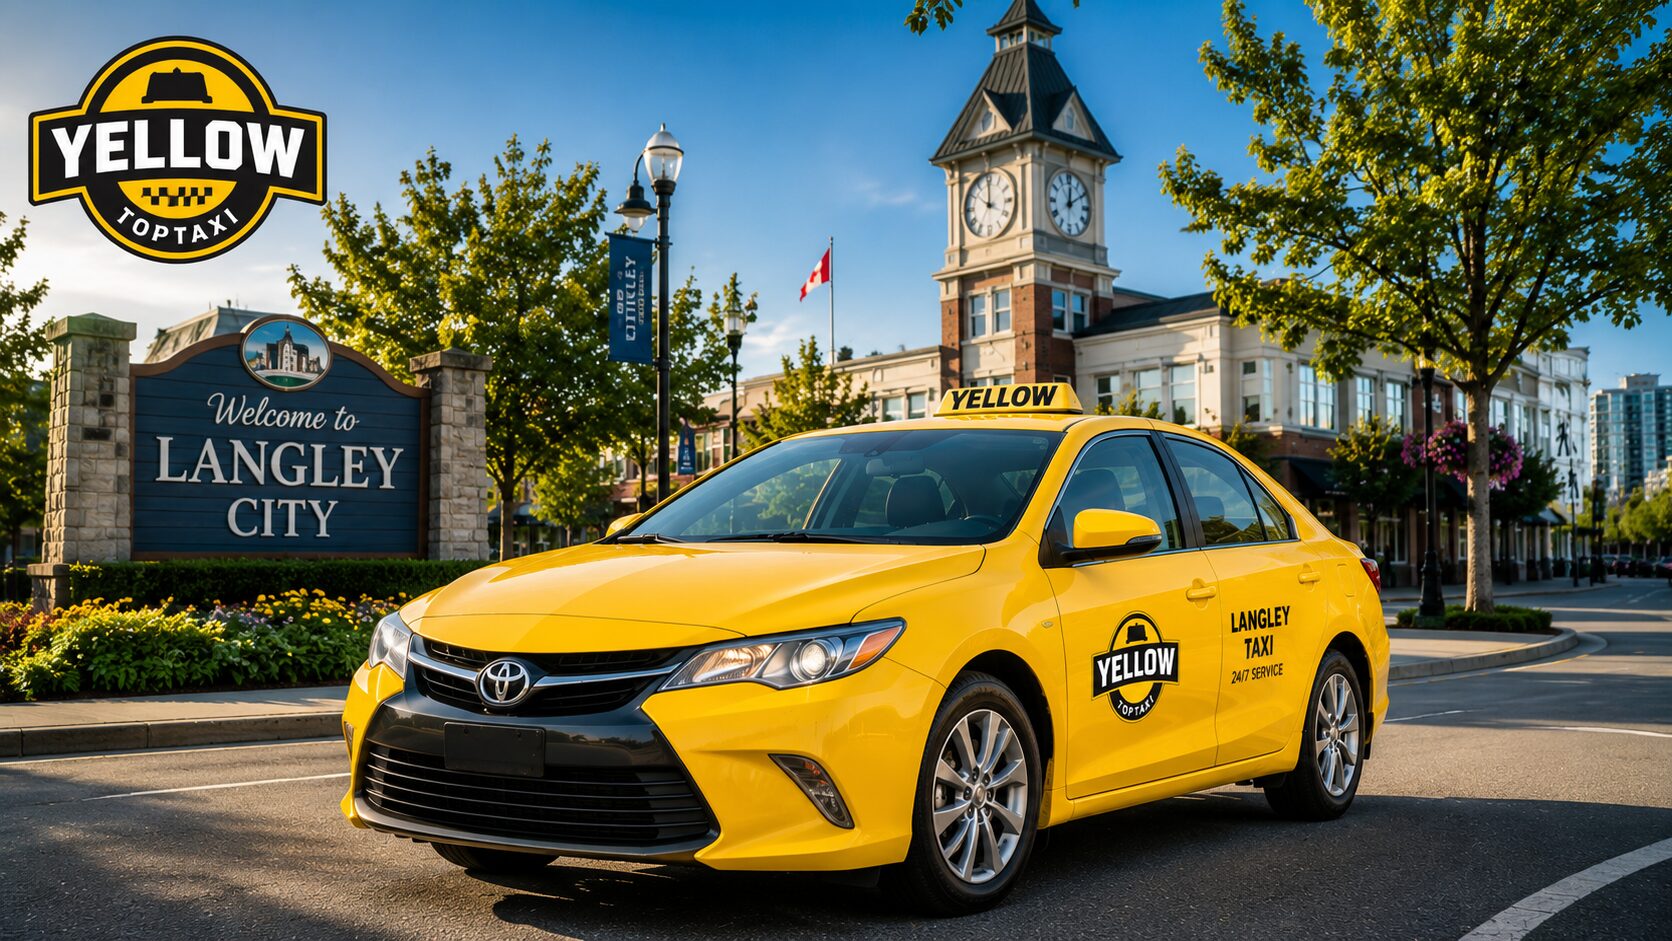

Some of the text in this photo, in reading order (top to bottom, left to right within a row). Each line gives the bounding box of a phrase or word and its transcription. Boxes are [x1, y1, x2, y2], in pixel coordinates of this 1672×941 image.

[207, 392, 360, 431] Welcome to
[951, 385, 1058, 411] YELLOW
[155, 436, 404, 489] LANGLEY
[227, 497, 338, 538] CITY
[1231, 605, 1290, 633] LANGLEY
[1244, 635, 1274, 659] TAXI
[1097, 647, 1176, 687] YELLOW
[1231, 663, 1283, 684] 24/7 SERVICE
[1117, 695, 1154, 717] TOPTAXI
